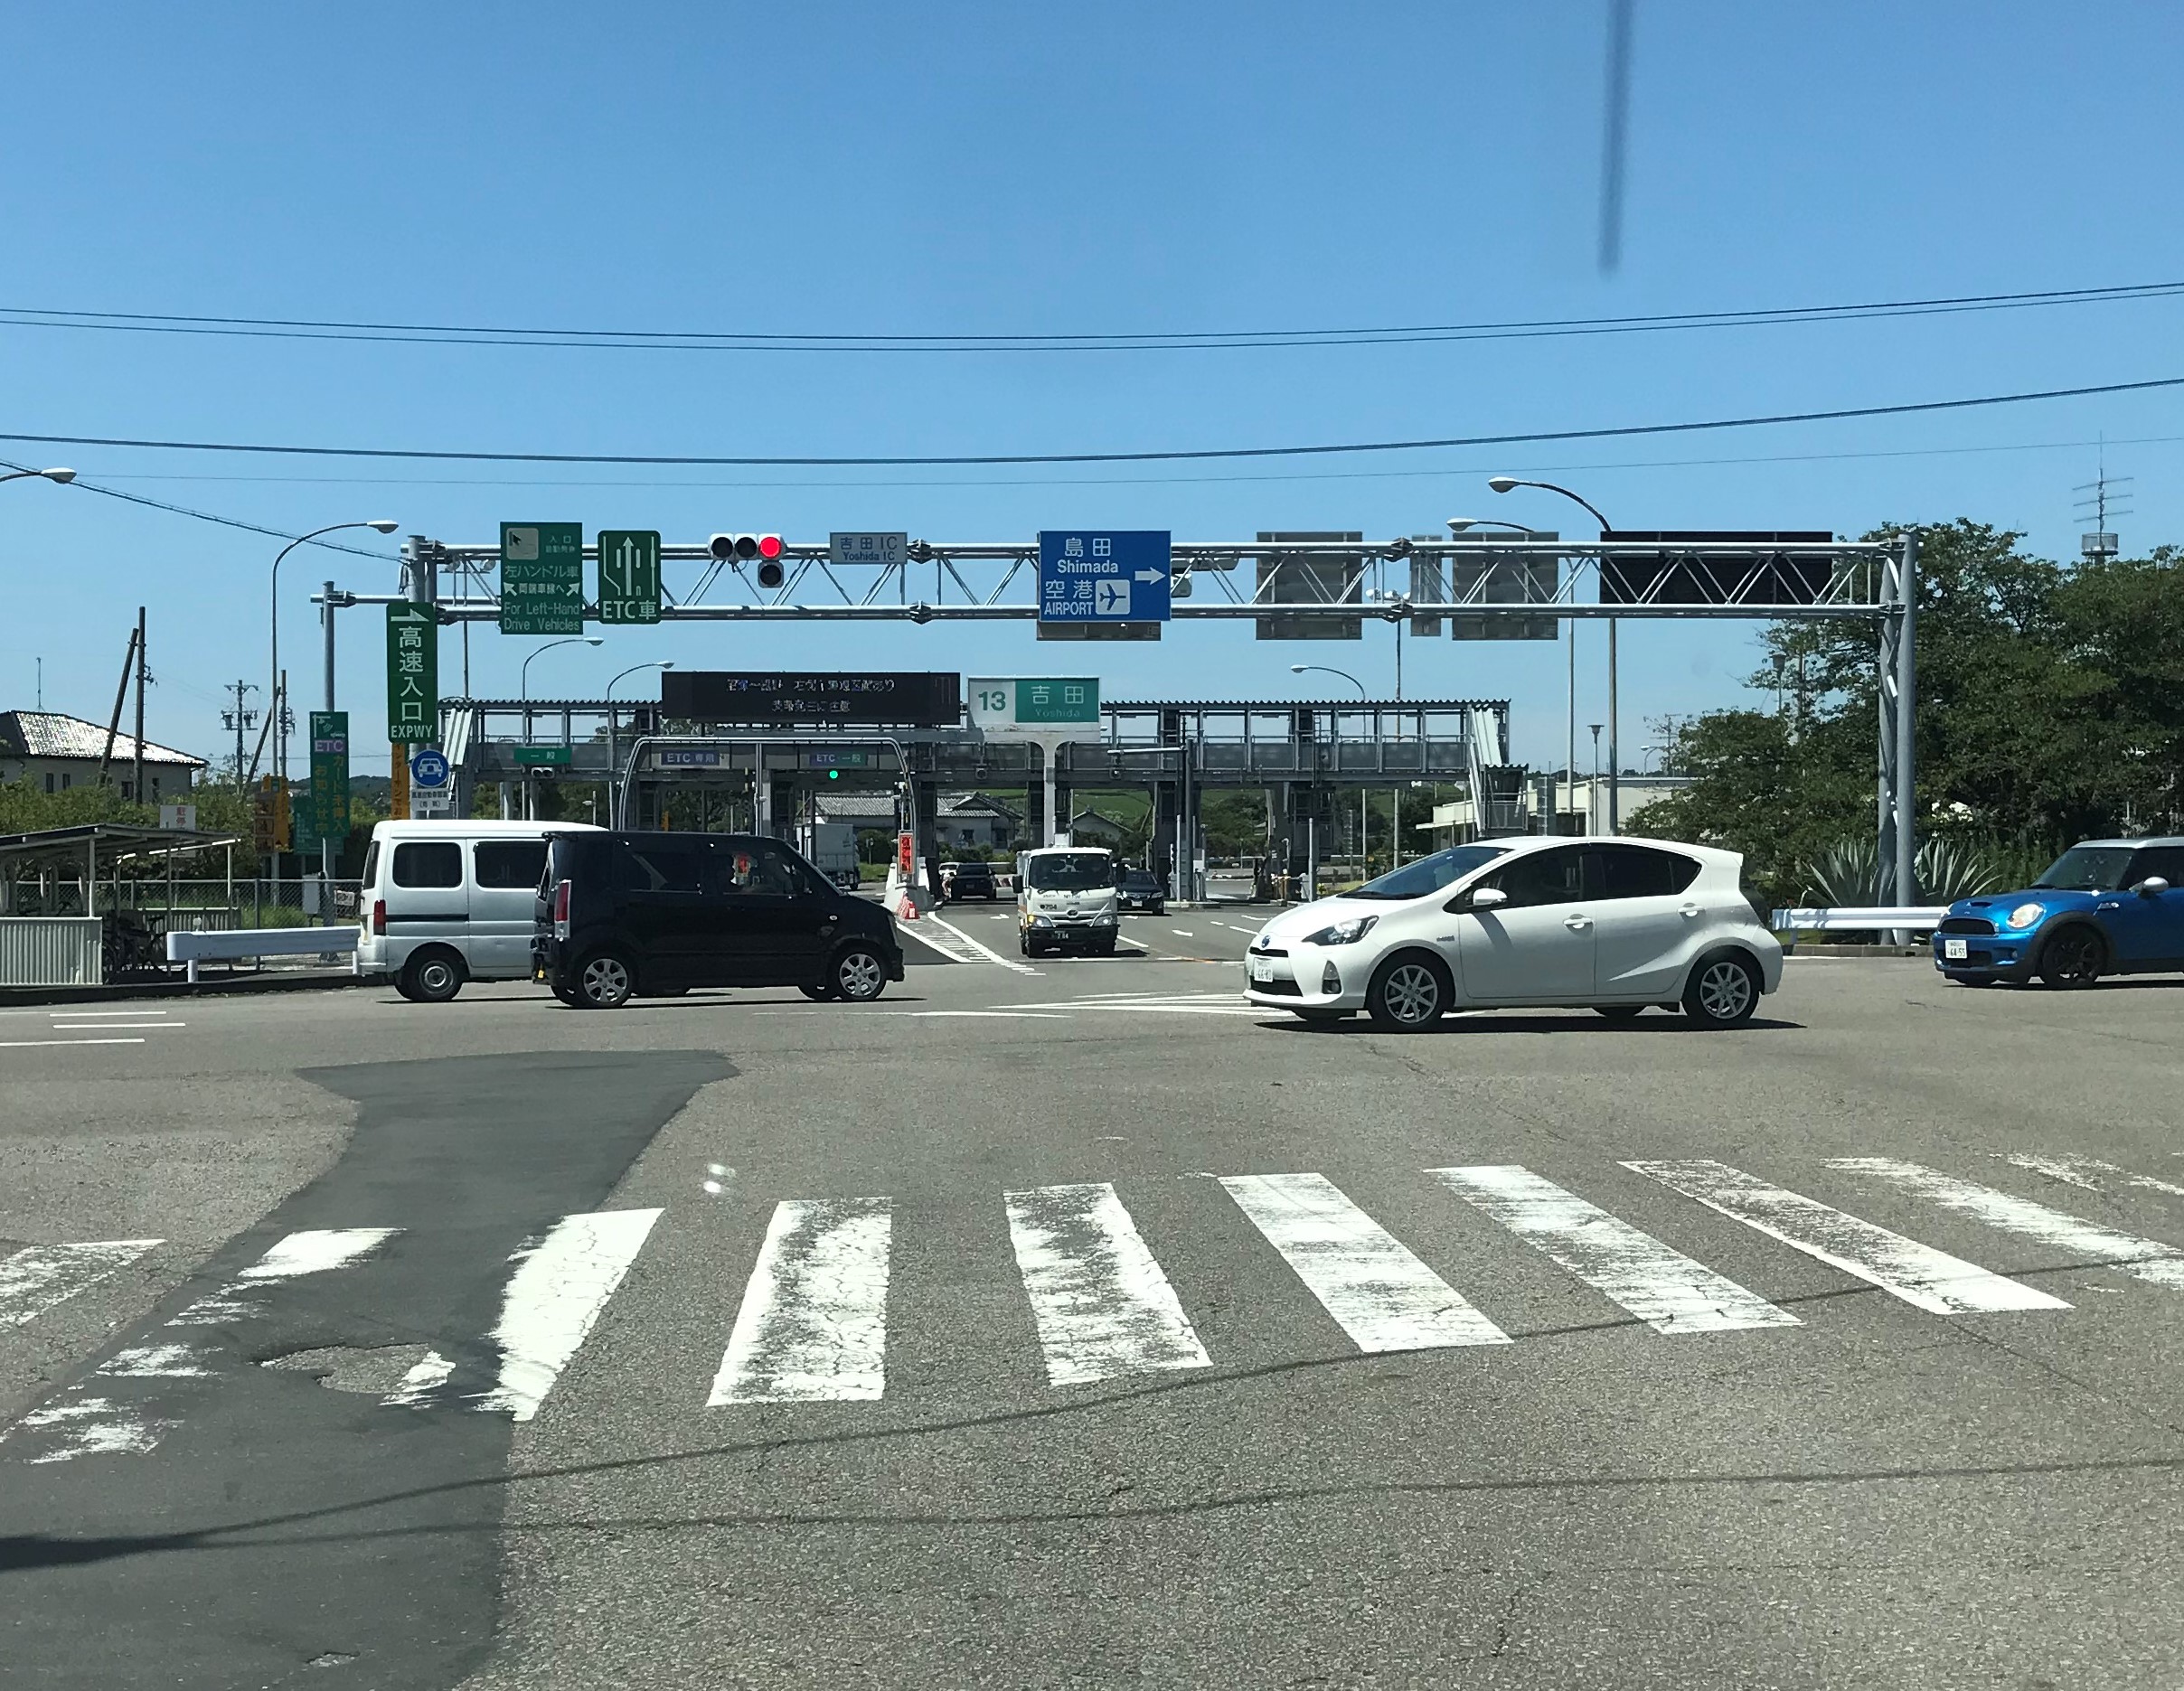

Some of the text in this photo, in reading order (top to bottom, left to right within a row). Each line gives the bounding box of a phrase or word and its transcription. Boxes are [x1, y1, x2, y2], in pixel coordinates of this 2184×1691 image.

[549, 535, 571, 544] 入口
[840, 536, 898, 550] 吉田 IC
[1065, 537, 1111, 557] 島田
[843, 551, 895, 560] Yoshida IC
[504, 565, 579, 578] 左ハンドル車
[1057, 559, 1119, 574] Shimada
[1045, 579, 1093, 599] 空港
[504, 602, 579, 615] For Left-Hand
[1044, 601, 1094, 615] AIRPORT
[504, 617, 579, 631] Drive Vehicles
[399, 626, 424, 721] 高速入口
[978, 690, 1006, 711] 13
[1031, 685, 1084, 704] 吉田
[1035, 708, 1080, 718] Yoshida
[391, 725, 433, 738] EXPWY
[315, 739, 344, 752] ETC
[531, 751, 556, 761] 一般
[667, 753, 691, 763] ETC
[816, 754, 835, 763] ETC
